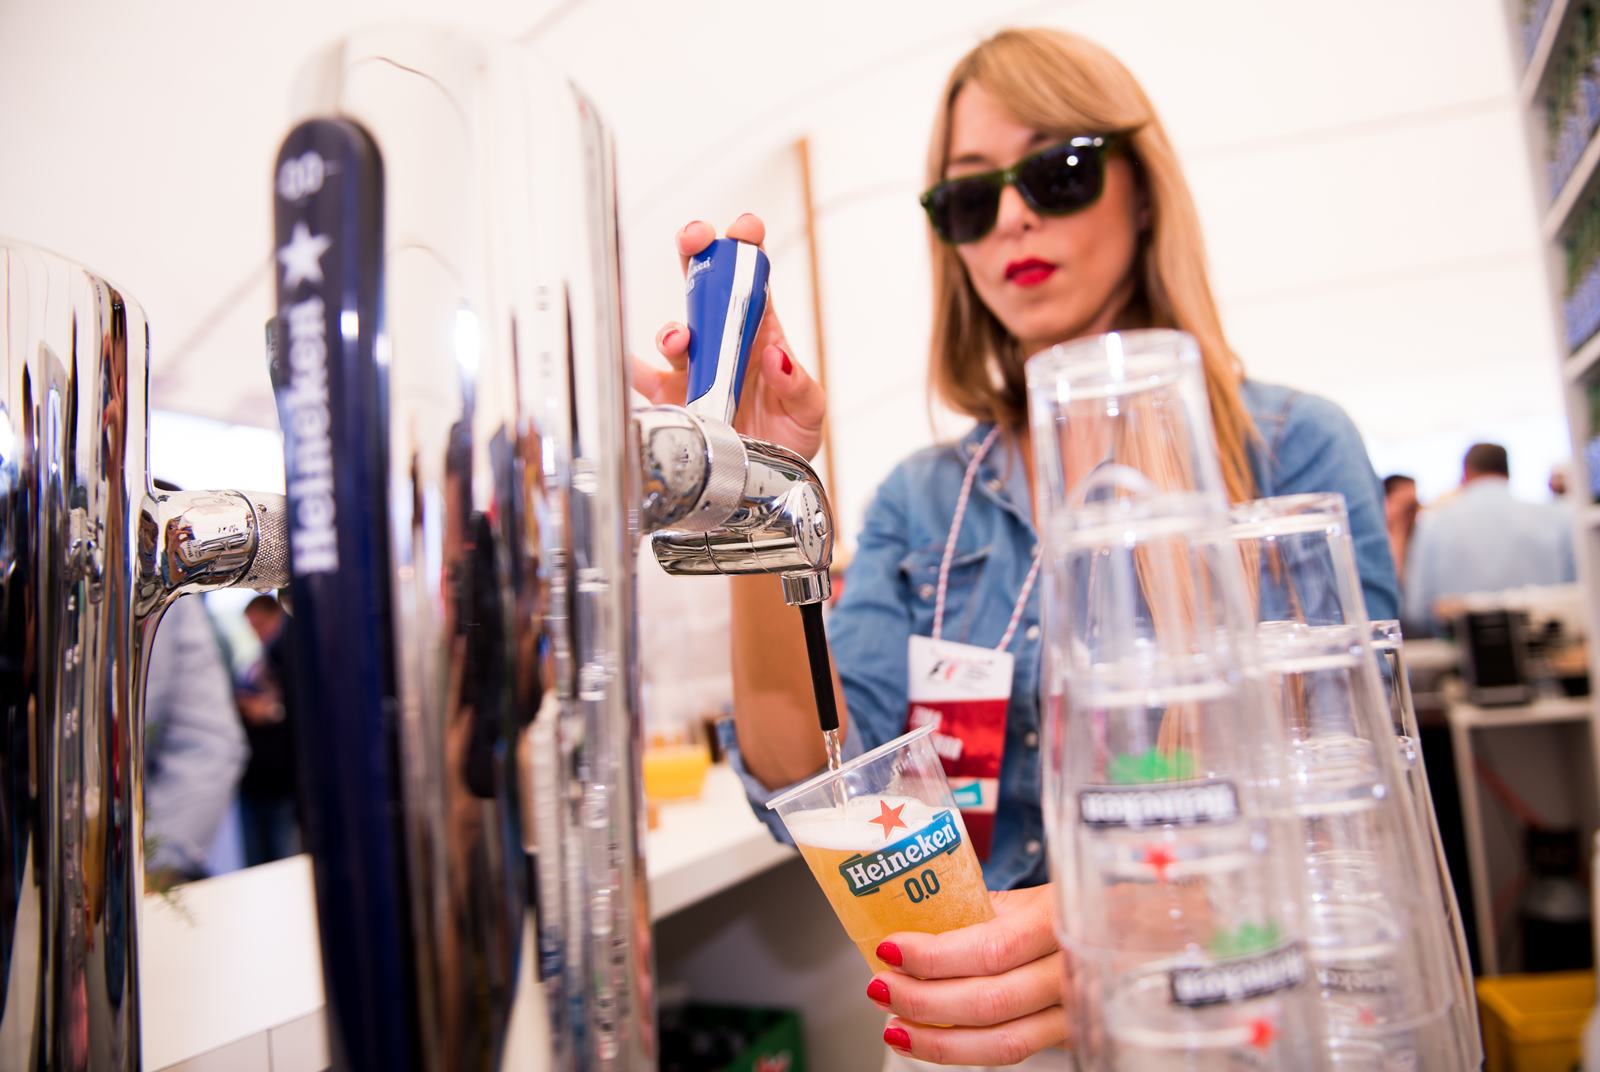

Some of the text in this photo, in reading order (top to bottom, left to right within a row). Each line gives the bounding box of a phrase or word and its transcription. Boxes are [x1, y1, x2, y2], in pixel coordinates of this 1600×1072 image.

[288, 297, 340, 574] Heineken
[846, 823, 957, 889] Heineken
[904, 868, 940, 904] 0.0
